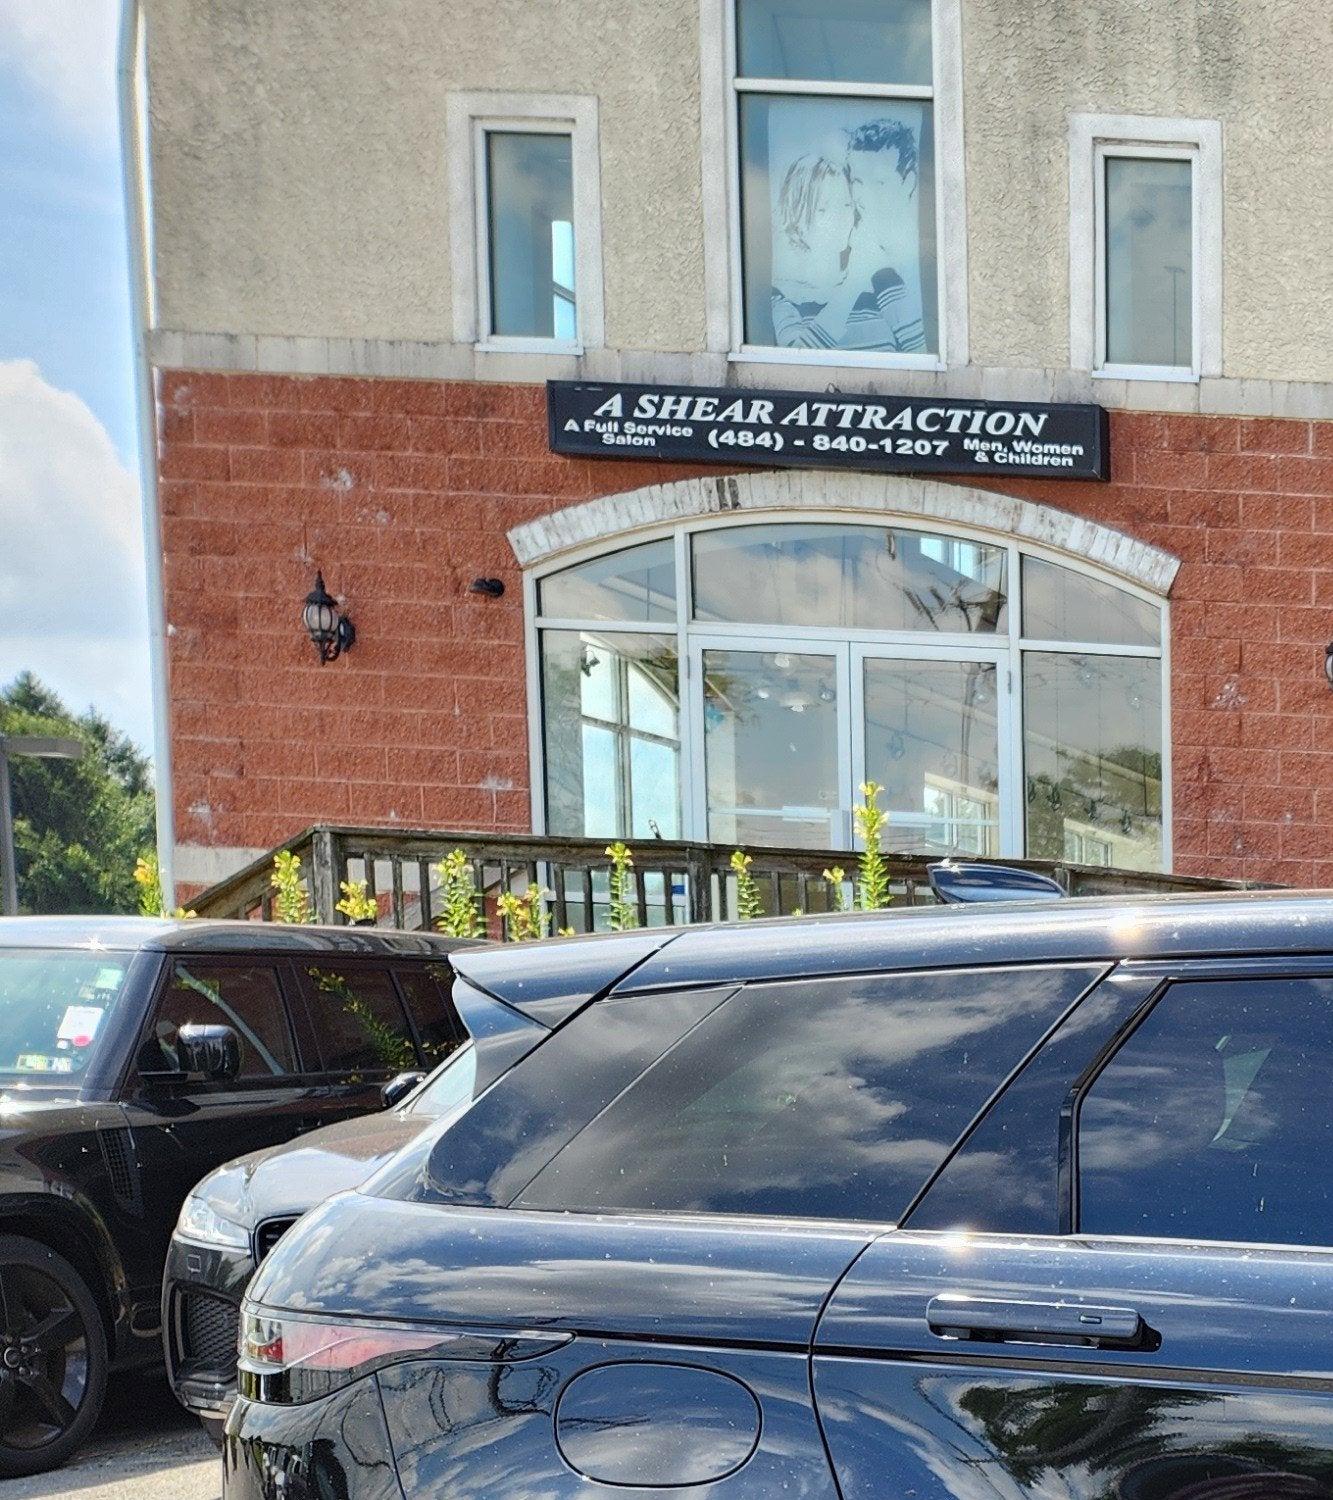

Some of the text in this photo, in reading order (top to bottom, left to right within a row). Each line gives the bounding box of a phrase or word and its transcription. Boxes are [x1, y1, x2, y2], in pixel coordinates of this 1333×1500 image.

[593, 392, 1048, 437] A SHEAR ATTRACTION
[563, 418, 693, 438] A Full Service
[602, 433, 656, 447] Salon
[708, 428, 784, 452] (484)
[812, 434, 950, 456] 840-1207
[963, 438, 1084, 456] Men, Women
[974, 451, 1074, 467] & Children
